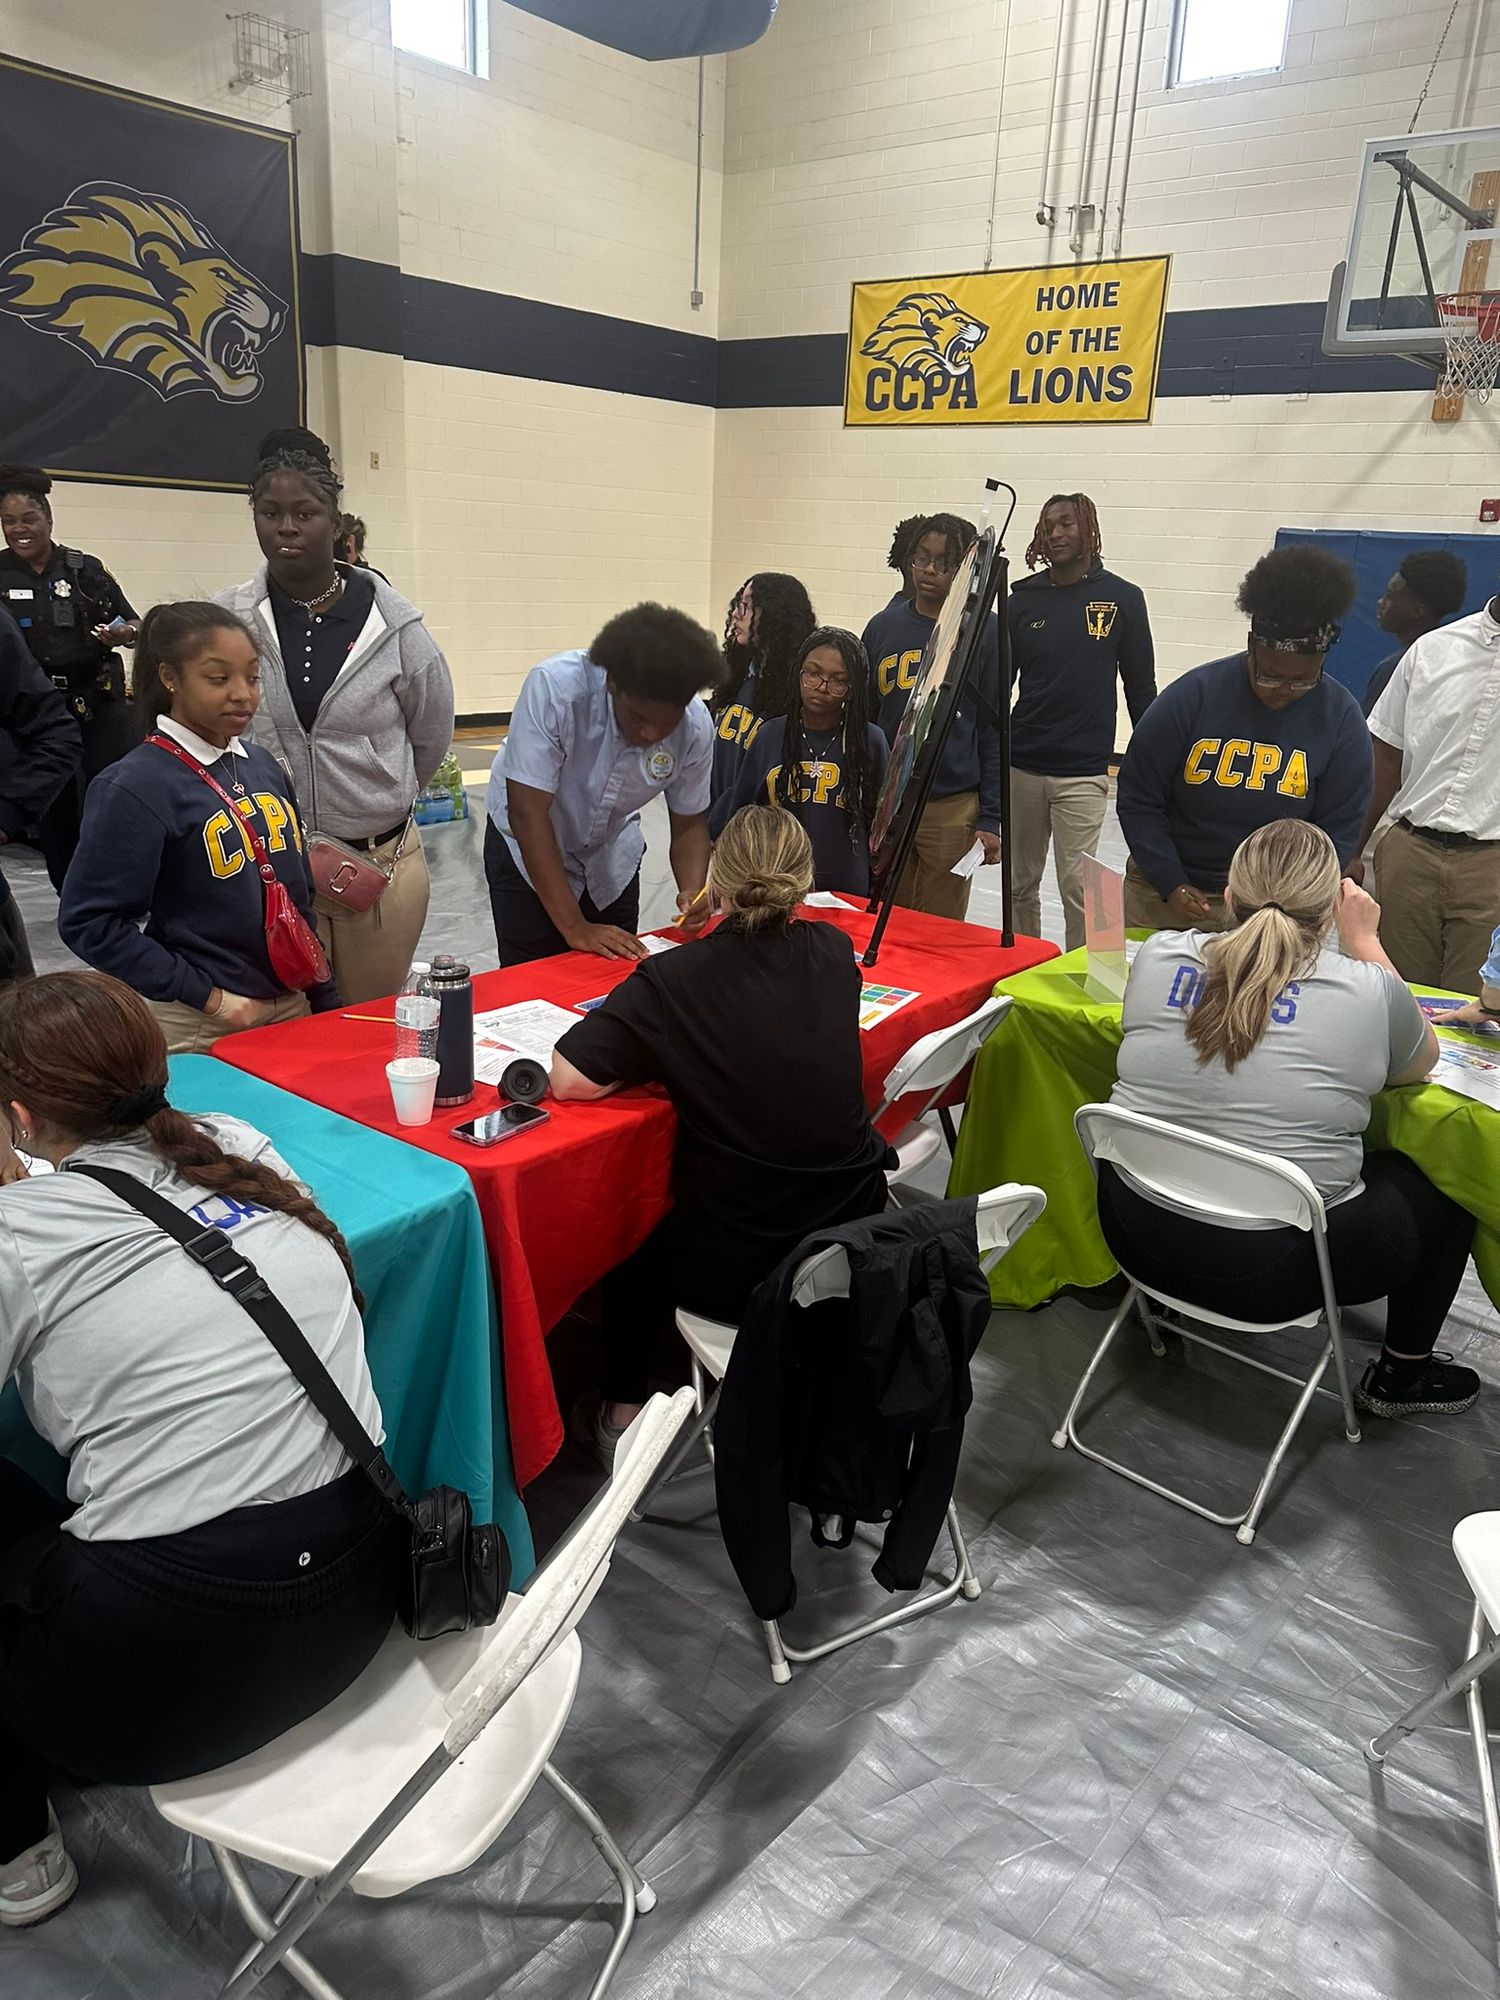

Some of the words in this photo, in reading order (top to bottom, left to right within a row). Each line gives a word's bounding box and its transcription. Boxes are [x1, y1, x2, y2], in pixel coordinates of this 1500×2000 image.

[1036, 281, 1121, 312] HOME
[1025, 329, 1064, 356] OF
[1068, 325, 1122, 354] THE
[865, 365, 979, 412] CCPA
[1008, 363, 1135, 406] LIONS
[1183, 738, 1309, 799] CCPA
